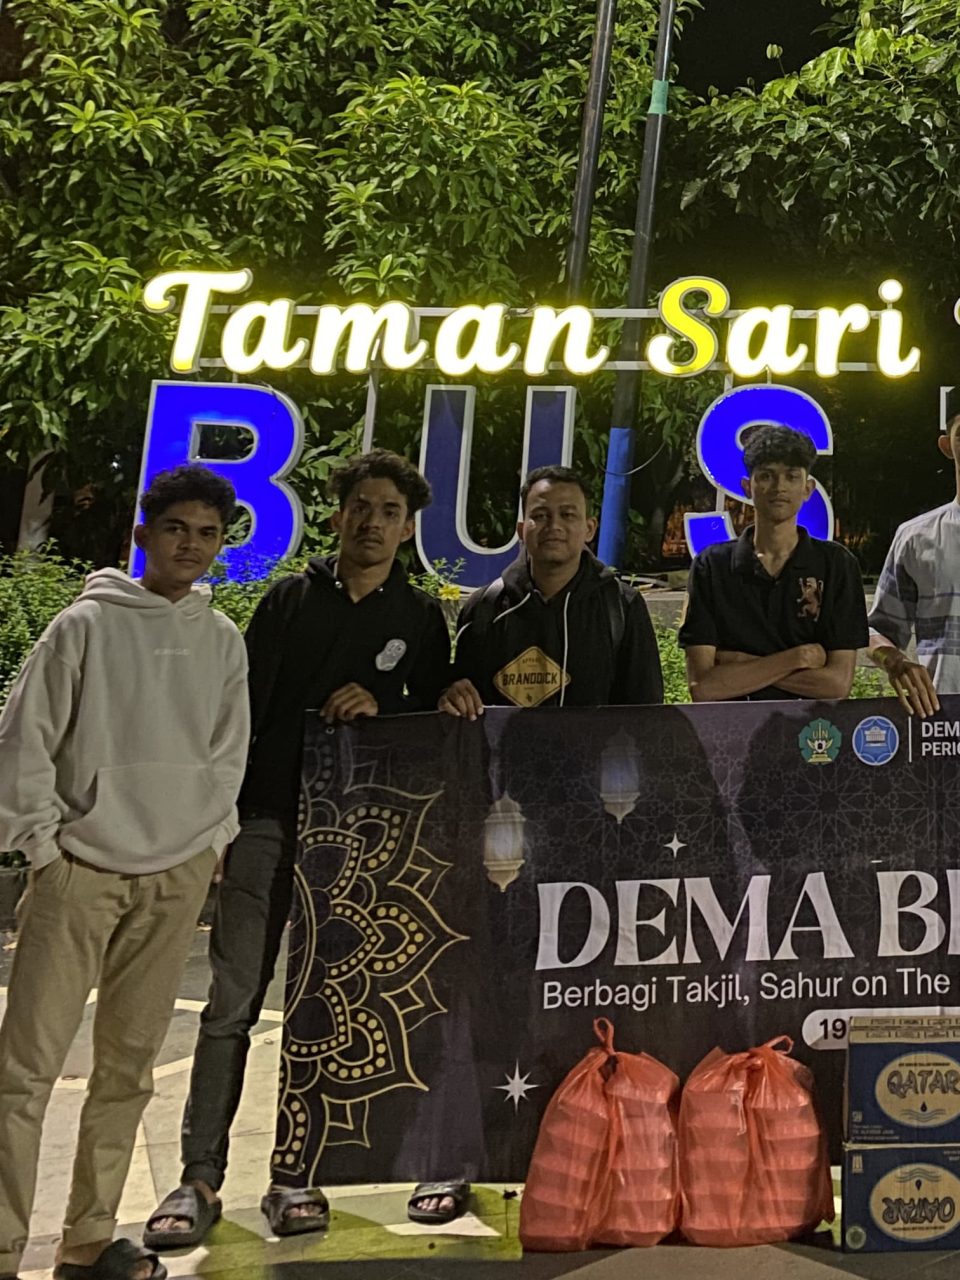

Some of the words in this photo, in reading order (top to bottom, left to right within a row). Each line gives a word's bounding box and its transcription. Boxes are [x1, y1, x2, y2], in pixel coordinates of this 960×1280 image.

[143, 268, 610, 376] Taman
[646, 275, 922, 378] Sari
[535, 872, 856, 971] DEMA
[543, 976, 657, 1011] Berbagi
[665, 973, 750, 1008] Takjil,
[759, 971, 843, 1000] Sahur
[852, 975, 887, 996] on
[895, 967, 951, 995] The
[819, 1018, 847, 1040] 19
